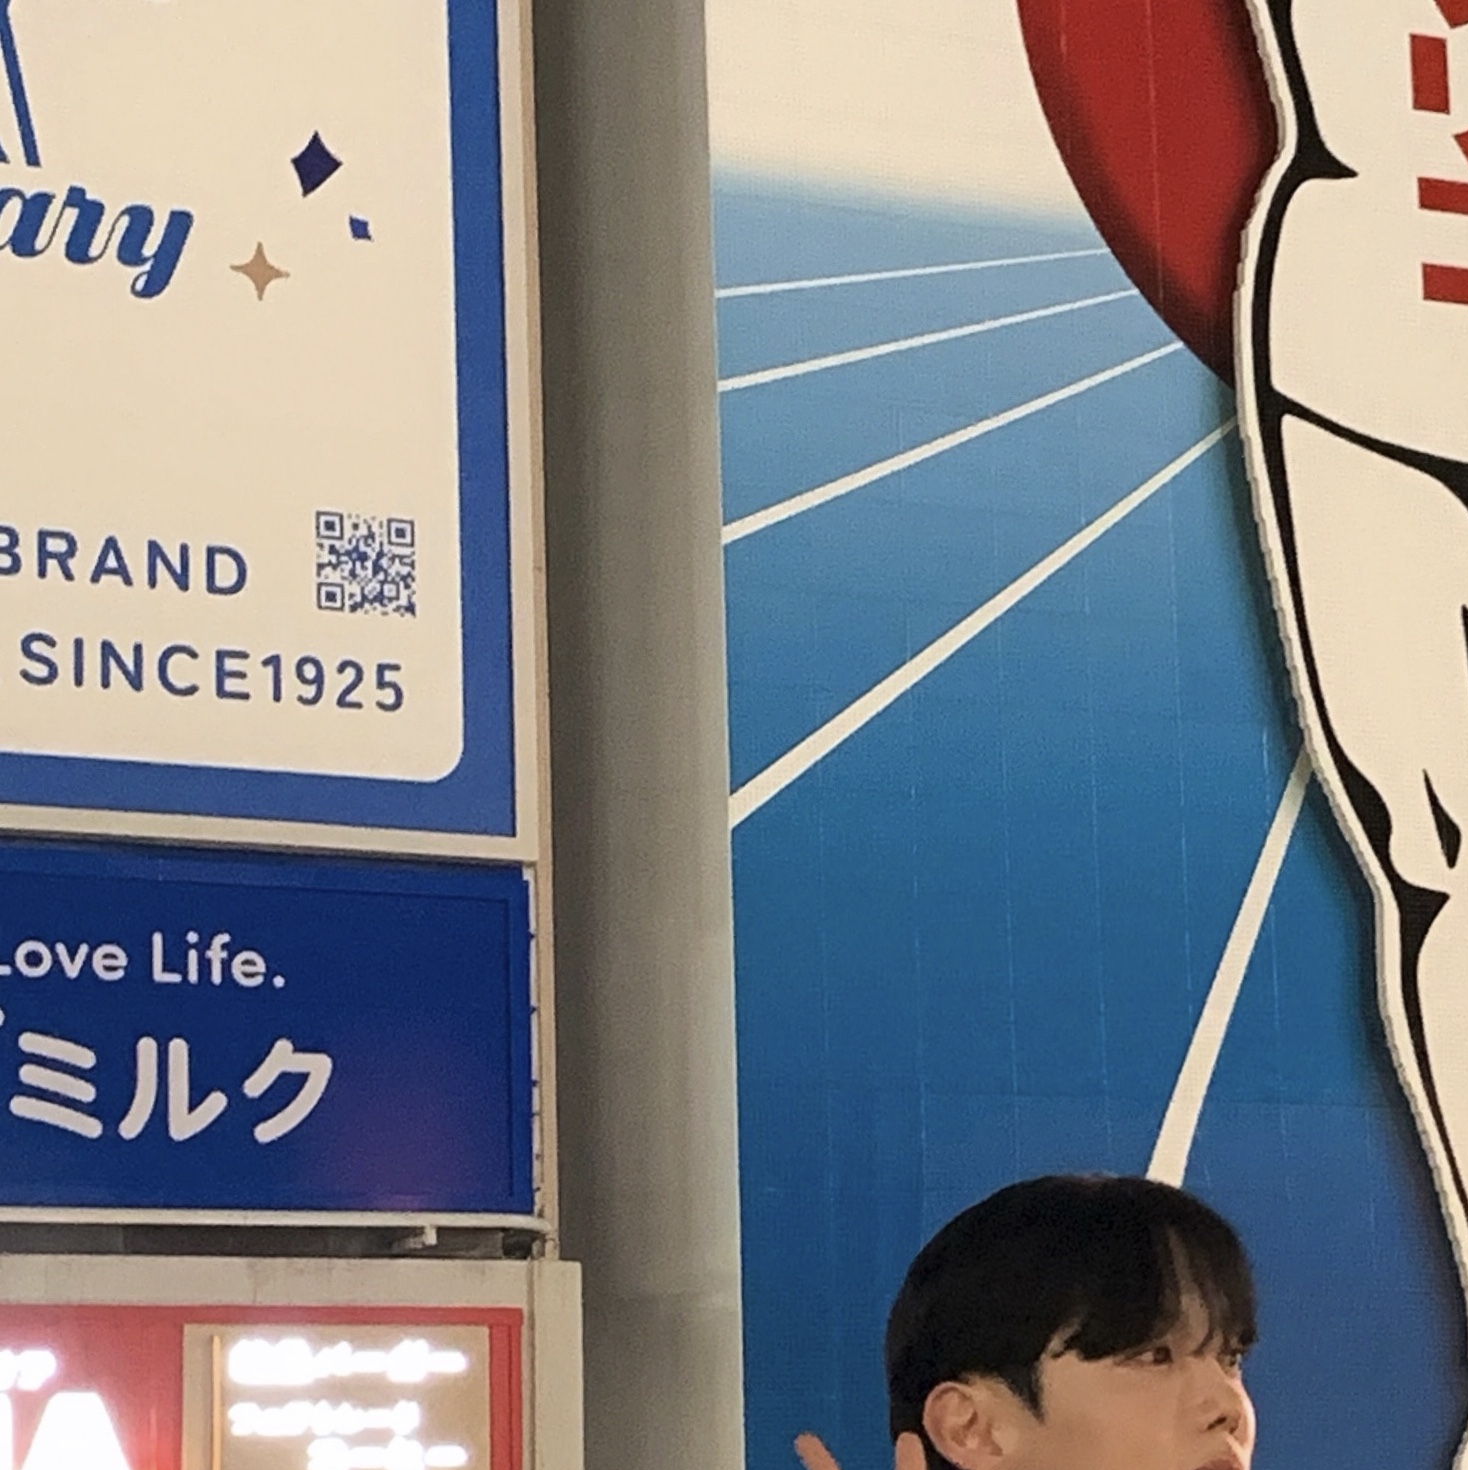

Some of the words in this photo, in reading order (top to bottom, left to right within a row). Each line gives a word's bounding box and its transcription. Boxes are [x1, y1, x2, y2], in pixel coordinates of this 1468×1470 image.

[19, 632, 405, 712] SINCE1925
[0, 938, 128, 981] ove
[152, 931, 286, 988] Life.
[0, 1010, 334, 1144] ミルク
